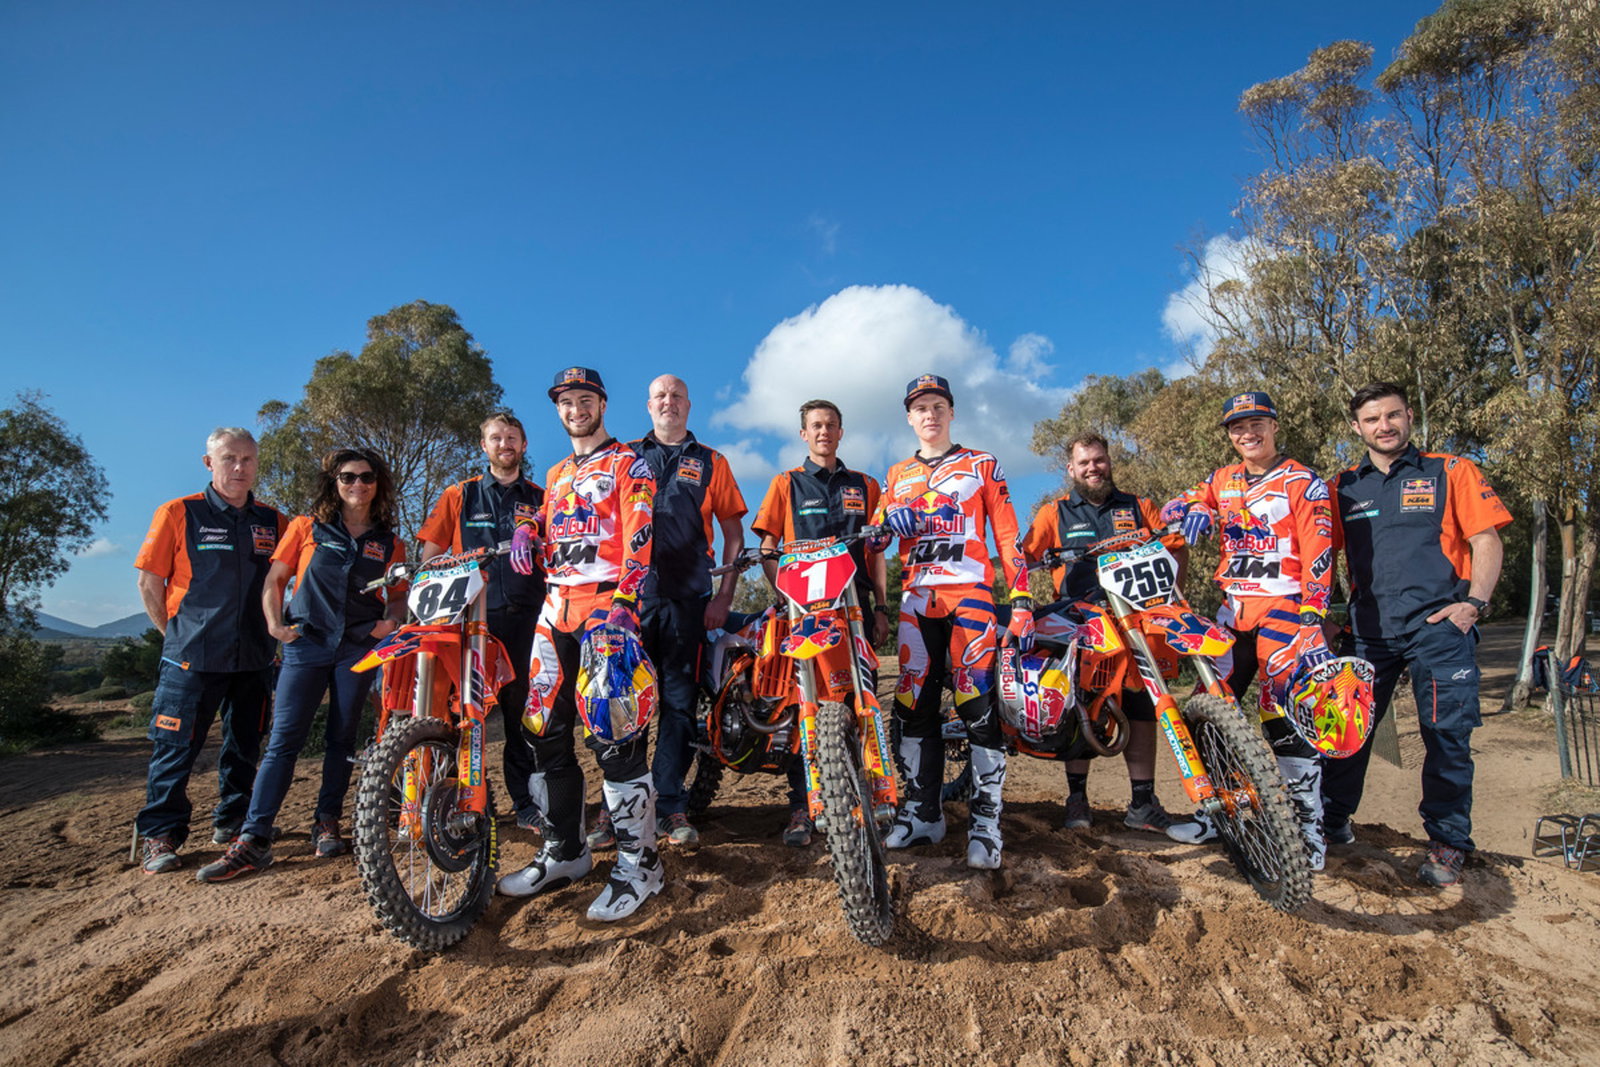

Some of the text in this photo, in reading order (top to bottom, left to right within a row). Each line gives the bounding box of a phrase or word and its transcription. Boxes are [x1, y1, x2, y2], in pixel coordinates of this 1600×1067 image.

[568, 516, 598, 535] Bull
[932, 514, 963, 533] Bull
[548, 539, 598, 568] KTM
[906, 538, 964, 566] KTM
[1222, 533, 1276, 551] Red Bull
[1113, 557, 1175, 602] 259
[1221, 554, 1280, 579] KTM
[800, 561, 828, 602] 1
[417, 576, 470, 621] 84
[1002, 648, 1017, 700] Red Bull
[159, 719, 177, 727] KTM
[1164, 729, 1192, 778] MOTOREX
